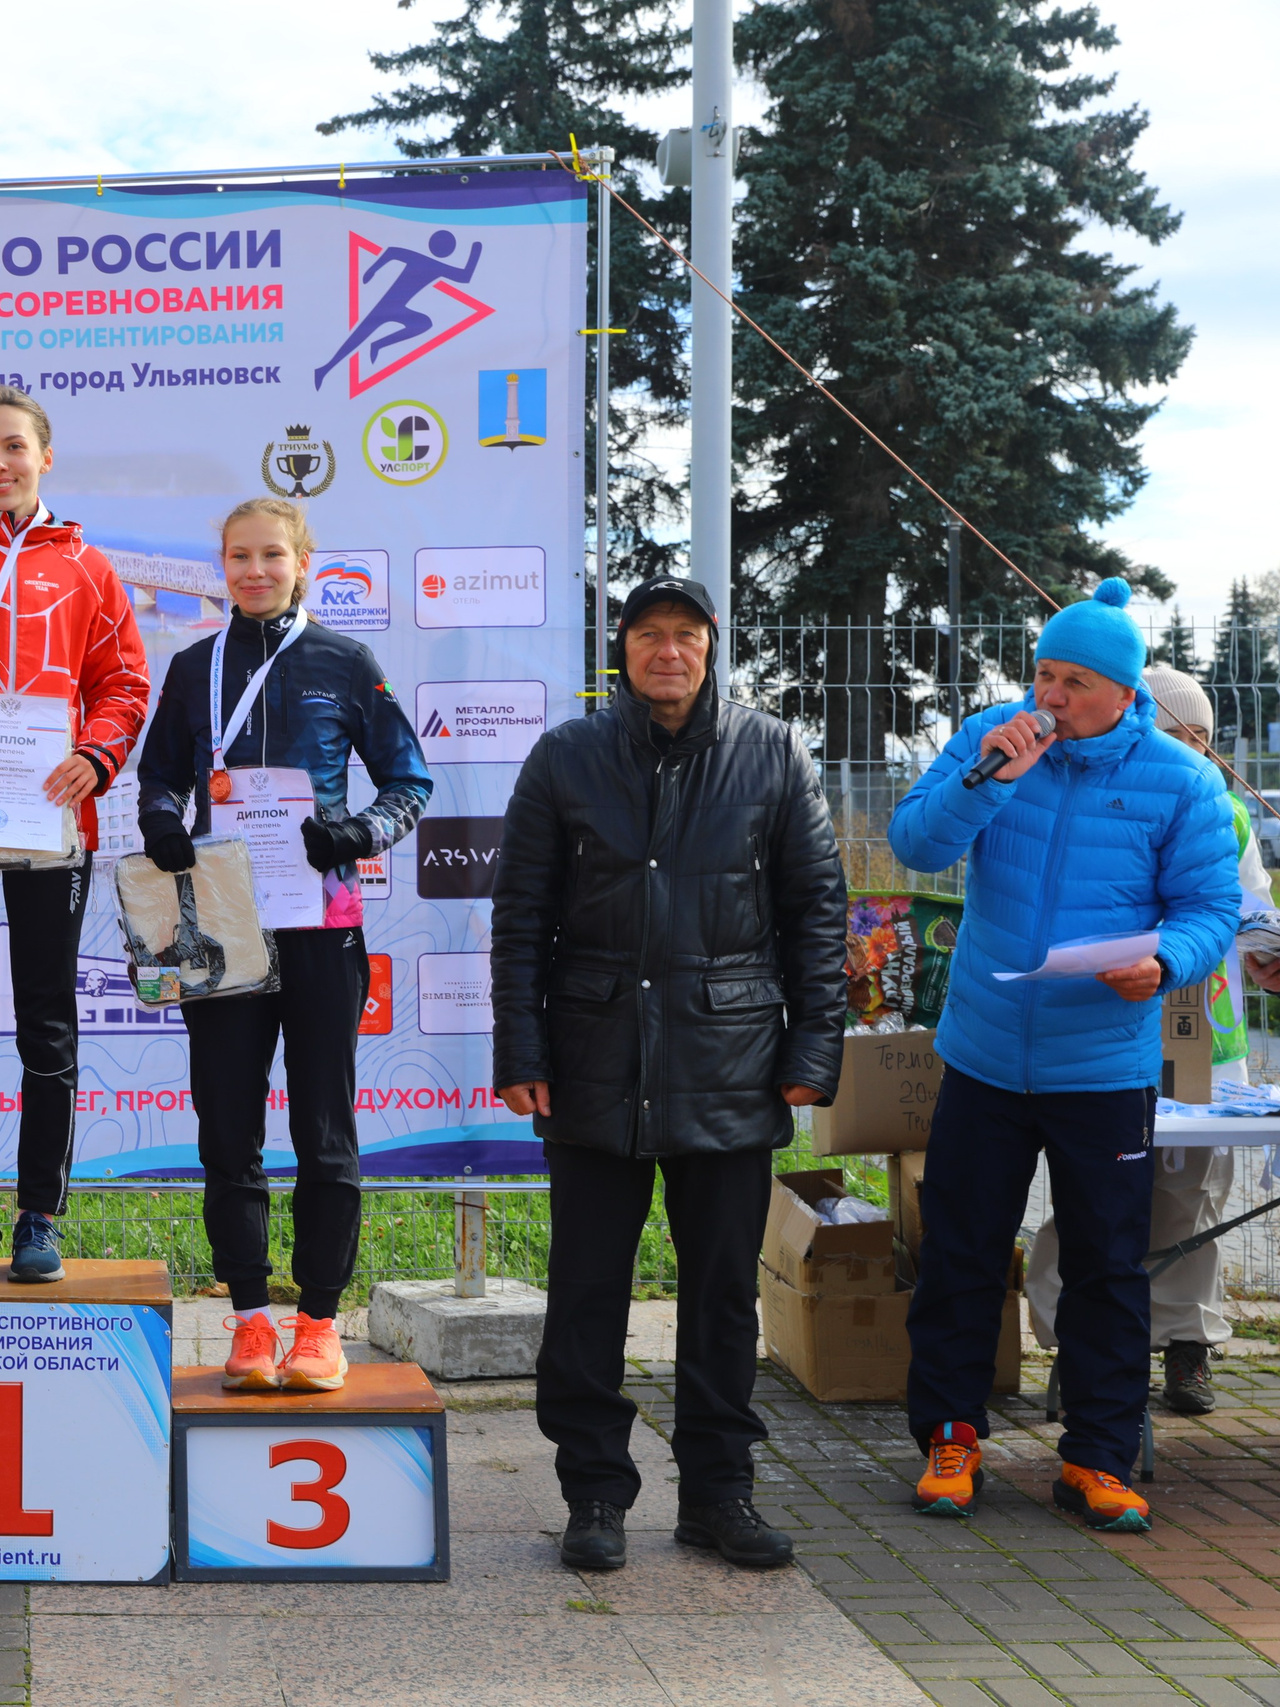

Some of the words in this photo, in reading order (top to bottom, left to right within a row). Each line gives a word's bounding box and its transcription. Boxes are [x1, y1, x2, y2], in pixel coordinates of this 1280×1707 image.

[57, 229, 281, 275] РОССИИ
[39, 322, 284, 350] ОРИЕНТИРОВАНИЯ
[40, 370, 124, 396] город
[131, 362, 281, 387] Ульяновск
[278, 443, 319, 452] ТРИУМФ
[380, 462, 430, 473] УЛСПОРТ
[452, 570, 540, 592] azimut
[452, 597, 481, 606] ОТЕЛЬ
[330, 608, 388, 617] ПОДДЕРЖКИ
[455, 706, 515, 714] МЕТАЛЛО
[455, 715, 543, 726] ПРОФИЛЬНЫЙ
[455, 729, 497, 738] ЗАВОД
[236, 808, 288, 821] ДИПЛОМ
[353, 1087, 461, 1114] ДУХОМ
[1116, 1150, 1147, 1161] FORWARD
[34, 1356, 120, 1372] ОБЛАСТИ
[266, 1438, 351, 1550] 3
